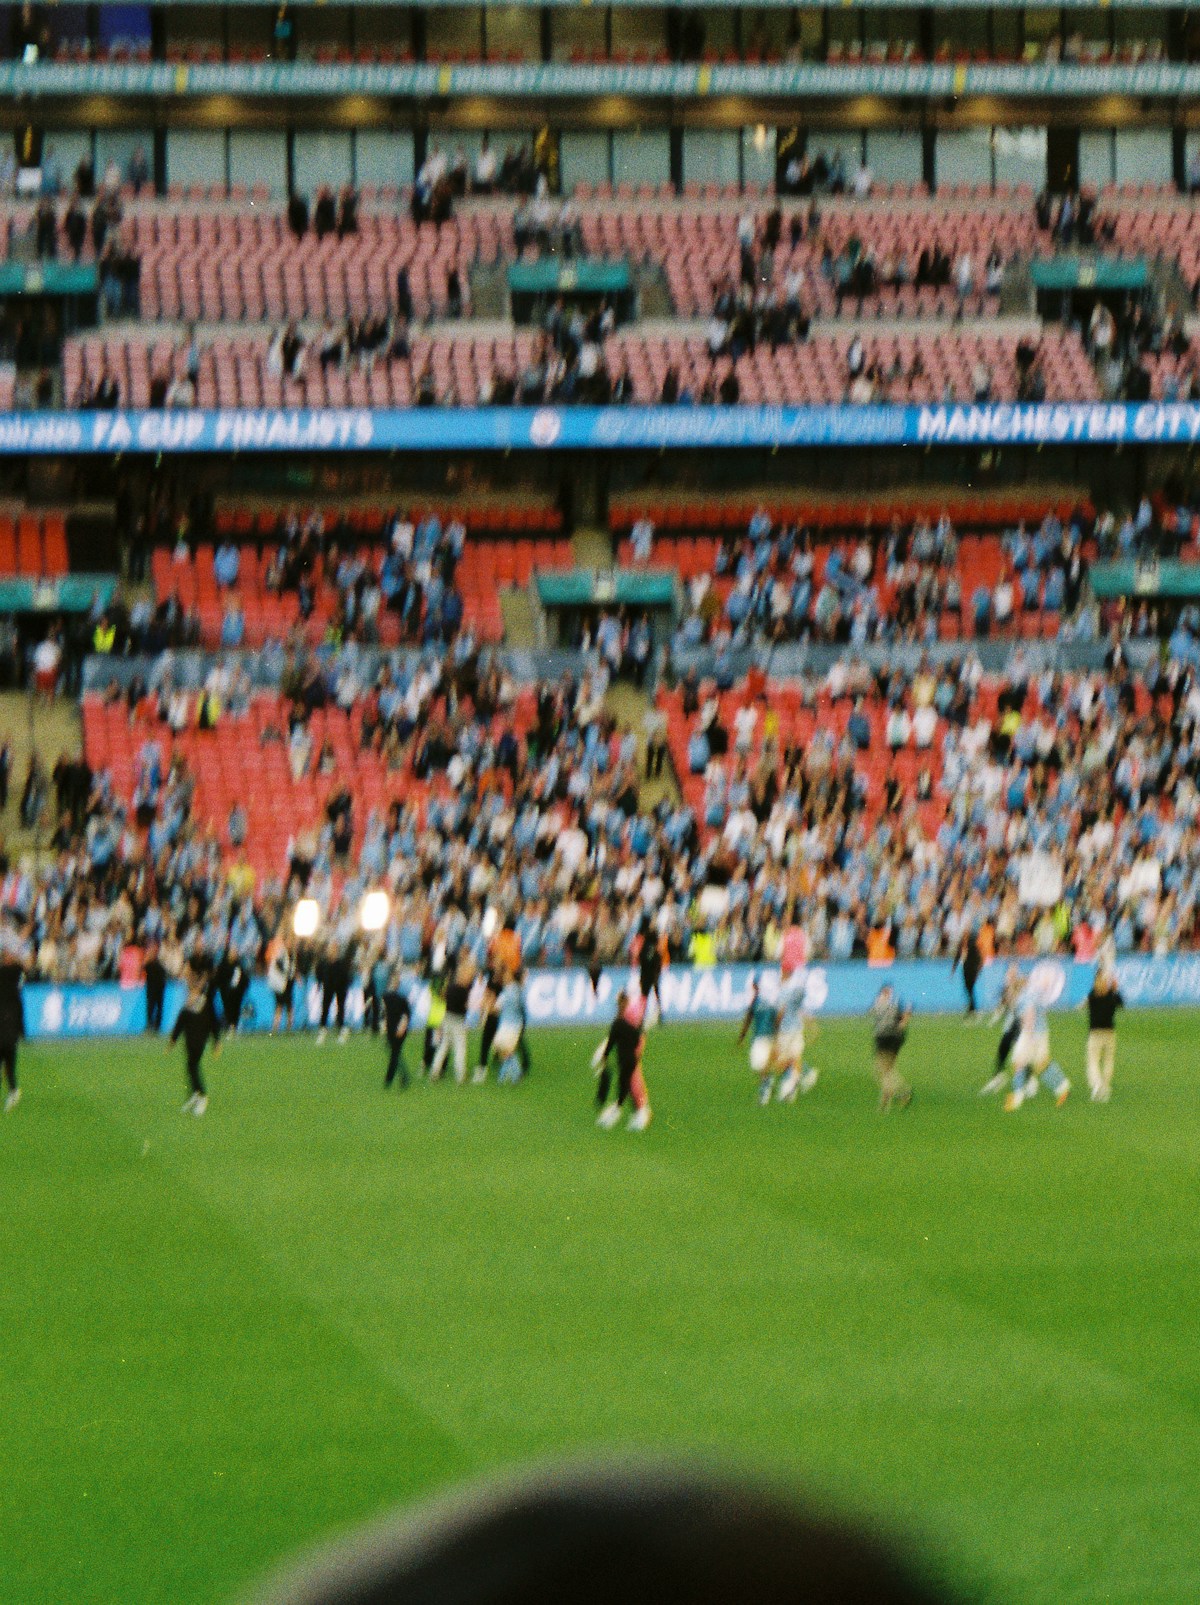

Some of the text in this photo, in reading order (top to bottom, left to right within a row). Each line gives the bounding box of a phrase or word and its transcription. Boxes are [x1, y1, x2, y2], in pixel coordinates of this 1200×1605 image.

[93, 413, 131, 448] FA
[138, 413, 205, 448] CUP
[216, 411, 373, 447] FINALISTS
[918, 404, 1127, 439] MANCHESTER
